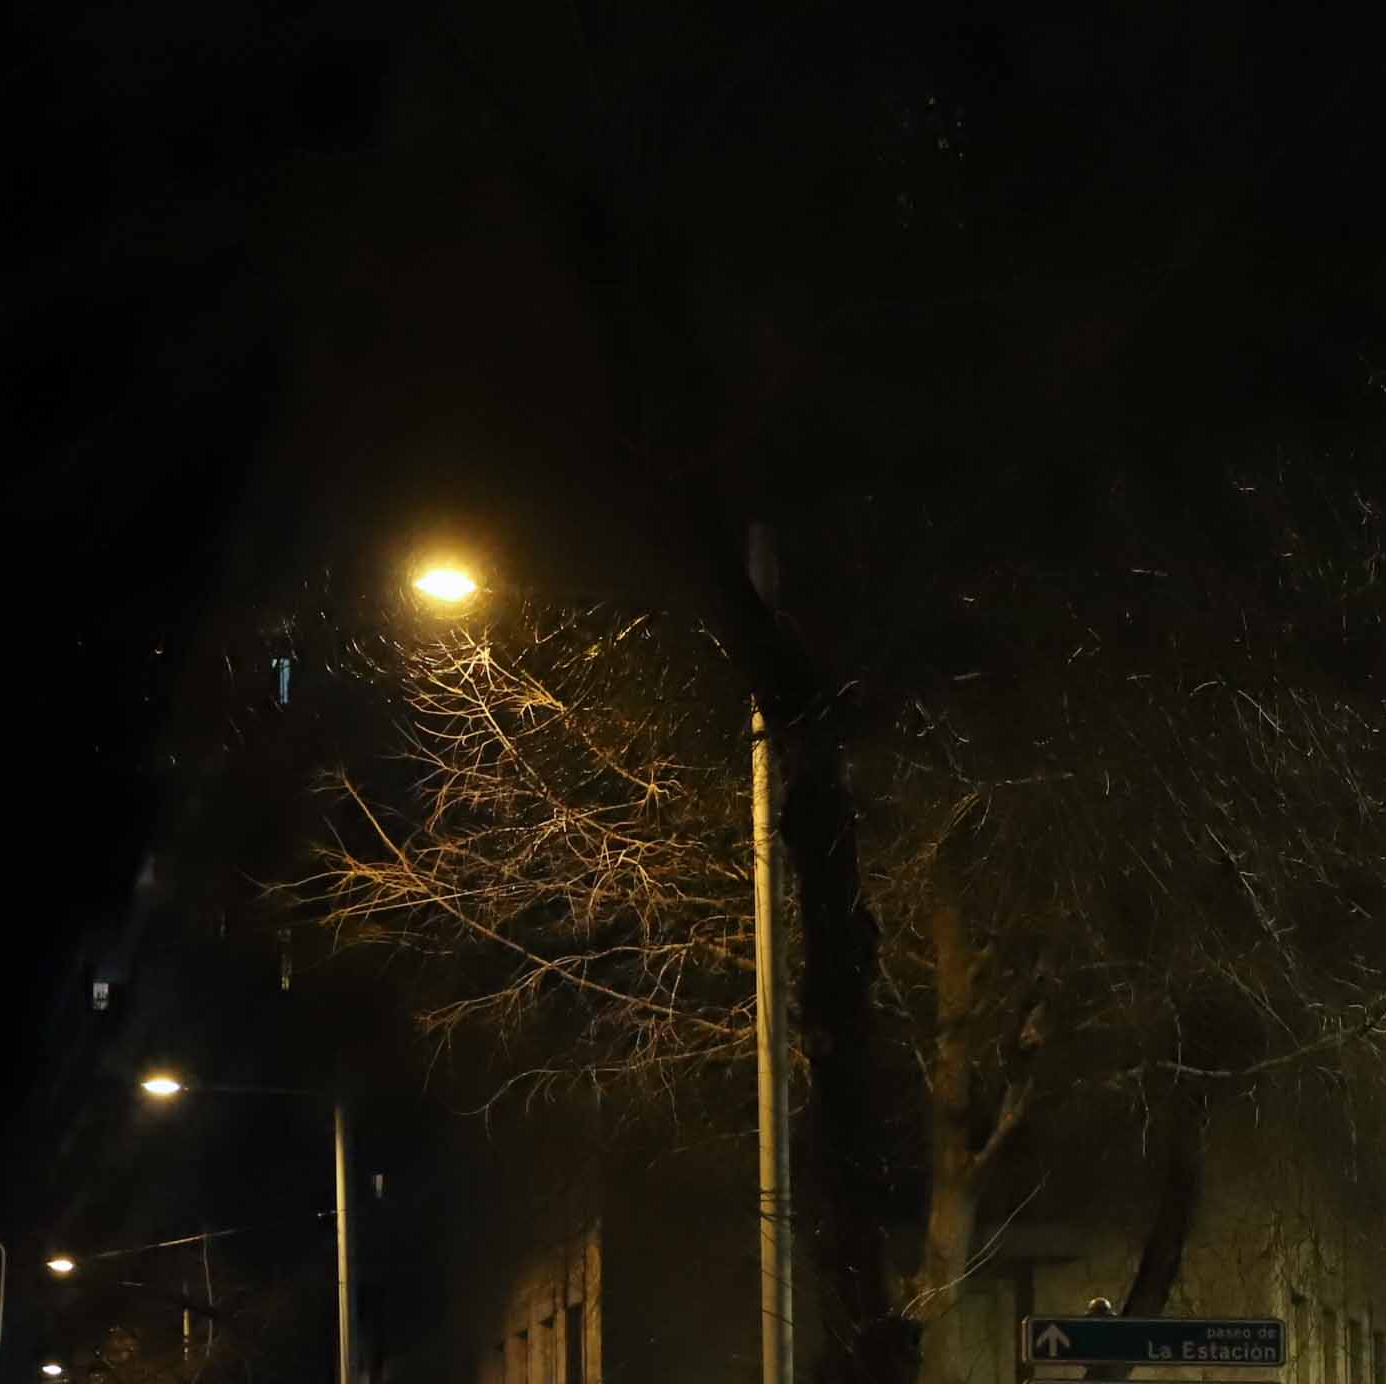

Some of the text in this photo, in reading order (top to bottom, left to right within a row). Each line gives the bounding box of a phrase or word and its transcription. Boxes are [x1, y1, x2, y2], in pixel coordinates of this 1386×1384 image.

[1207, 1327, 1277, 1342] paseo de
[1148, 1339, 1277, 1361] La Estación
